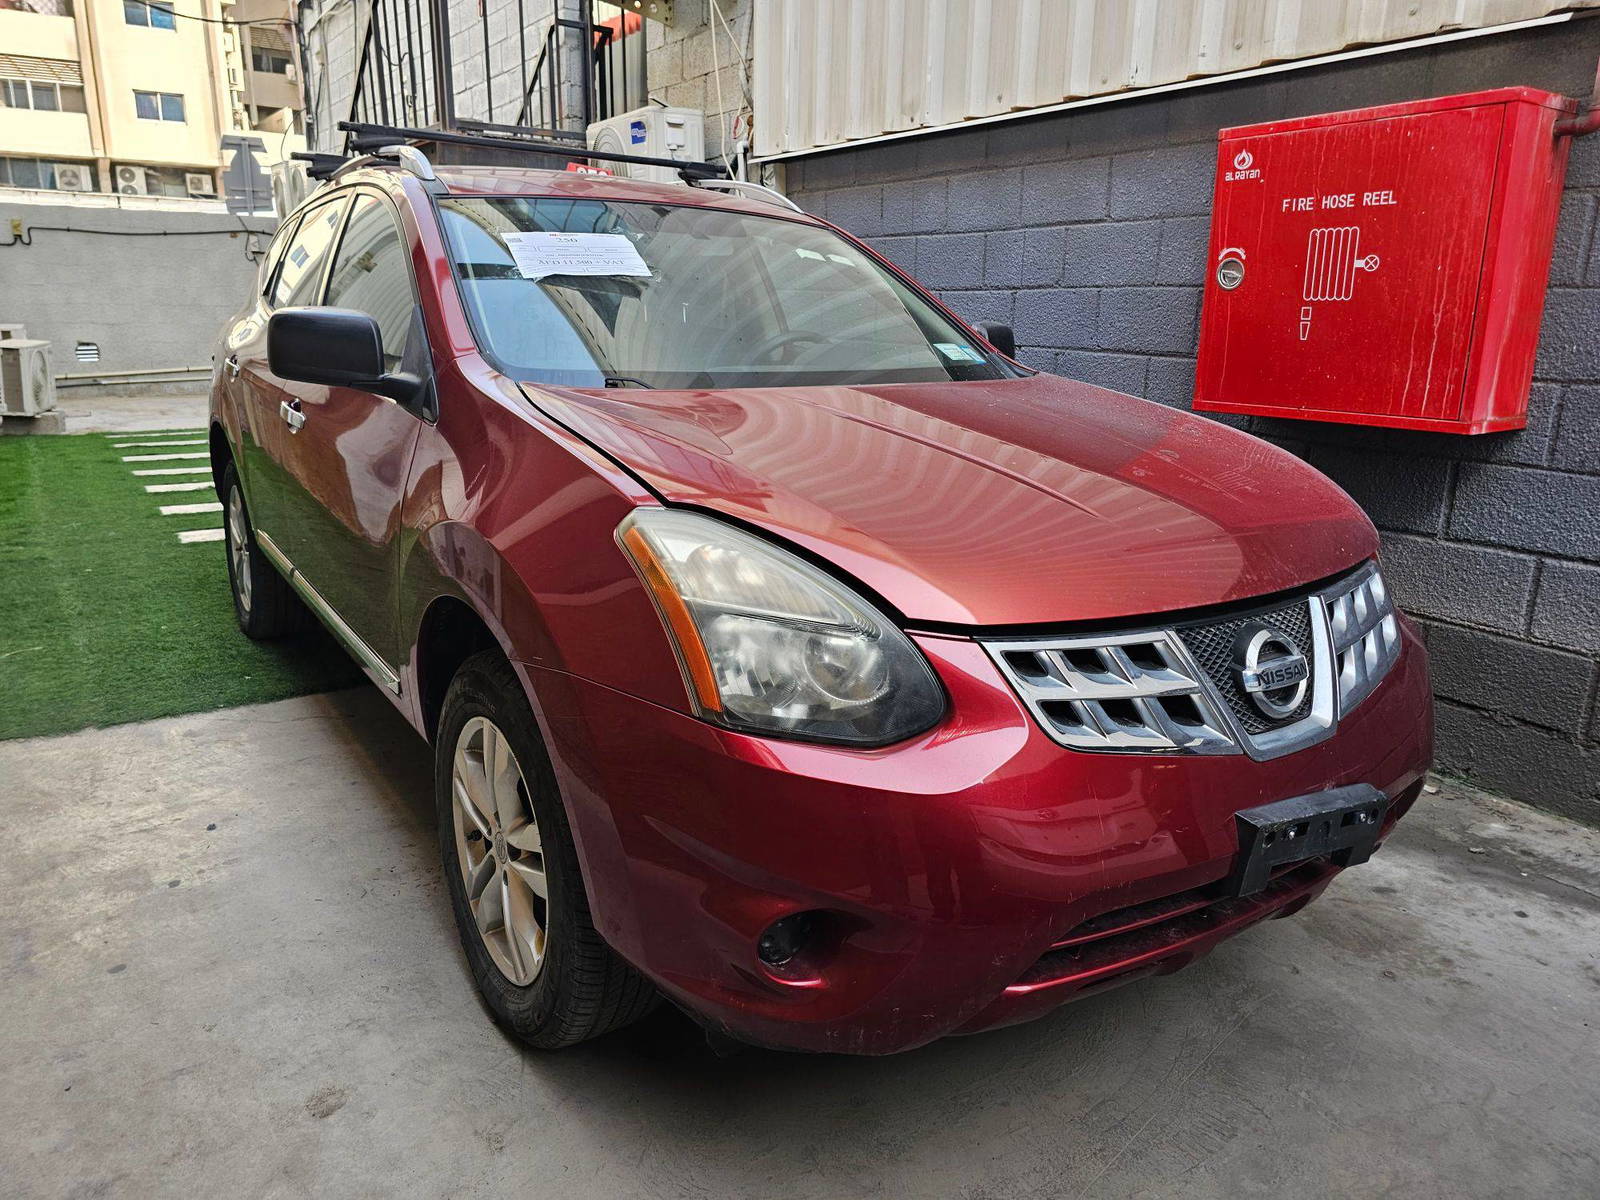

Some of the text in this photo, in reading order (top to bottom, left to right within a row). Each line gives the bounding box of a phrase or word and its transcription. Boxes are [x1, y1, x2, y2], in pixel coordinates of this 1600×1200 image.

[1281, 190, 1398, 213] FIRE HOSE REEL
[1256, 661, 1307, 686] NISSAN
